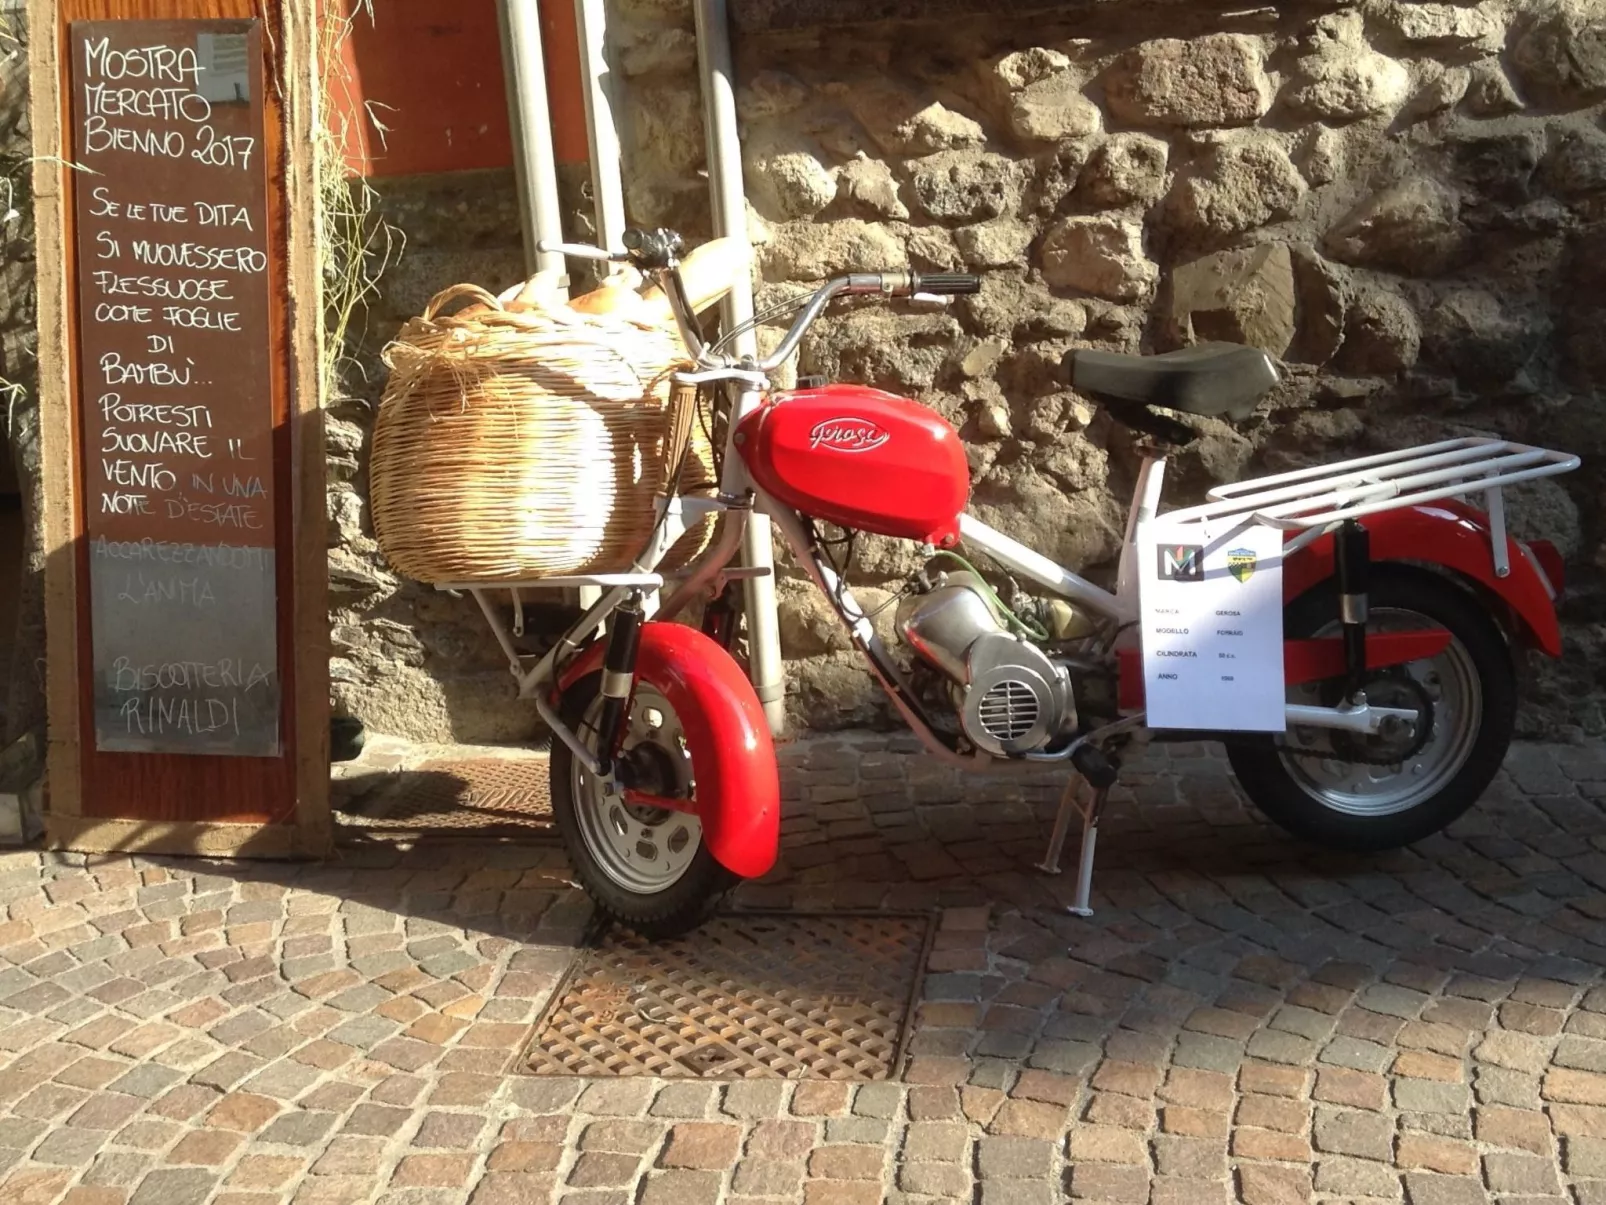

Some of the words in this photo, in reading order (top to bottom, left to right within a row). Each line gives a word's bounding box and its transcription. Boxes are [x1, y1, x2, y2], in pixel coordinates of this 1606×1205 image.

[84, 36, 206, 85] MOSTRA
[84, 82, 211, 122] MERCATO
[84, 115, 184, 157] BIENNO
[191, 124, 255, 171] 2017
[194, 201, 253, 232] DITA
[147, 334, 175, 354] DI
[98, 392, 213, 428] POTRESTI
[101, 426, 213, 458] SUONARE
[228, 438, 255, 461] IL
[102, 458, 177, 492] VENTO
[191, 473, 214, 494] IN
[221, 474, 268, 499] UNA
[1155, 627, 1190, 635] MODELLO
[1156, 650, 1198, 658] CILINDRATA
[113, 656, 275, 692] BISCOTTERIA
[1158, 672, 1179, 681] ANNO
[120, 697, 240, 736] RINALDI
